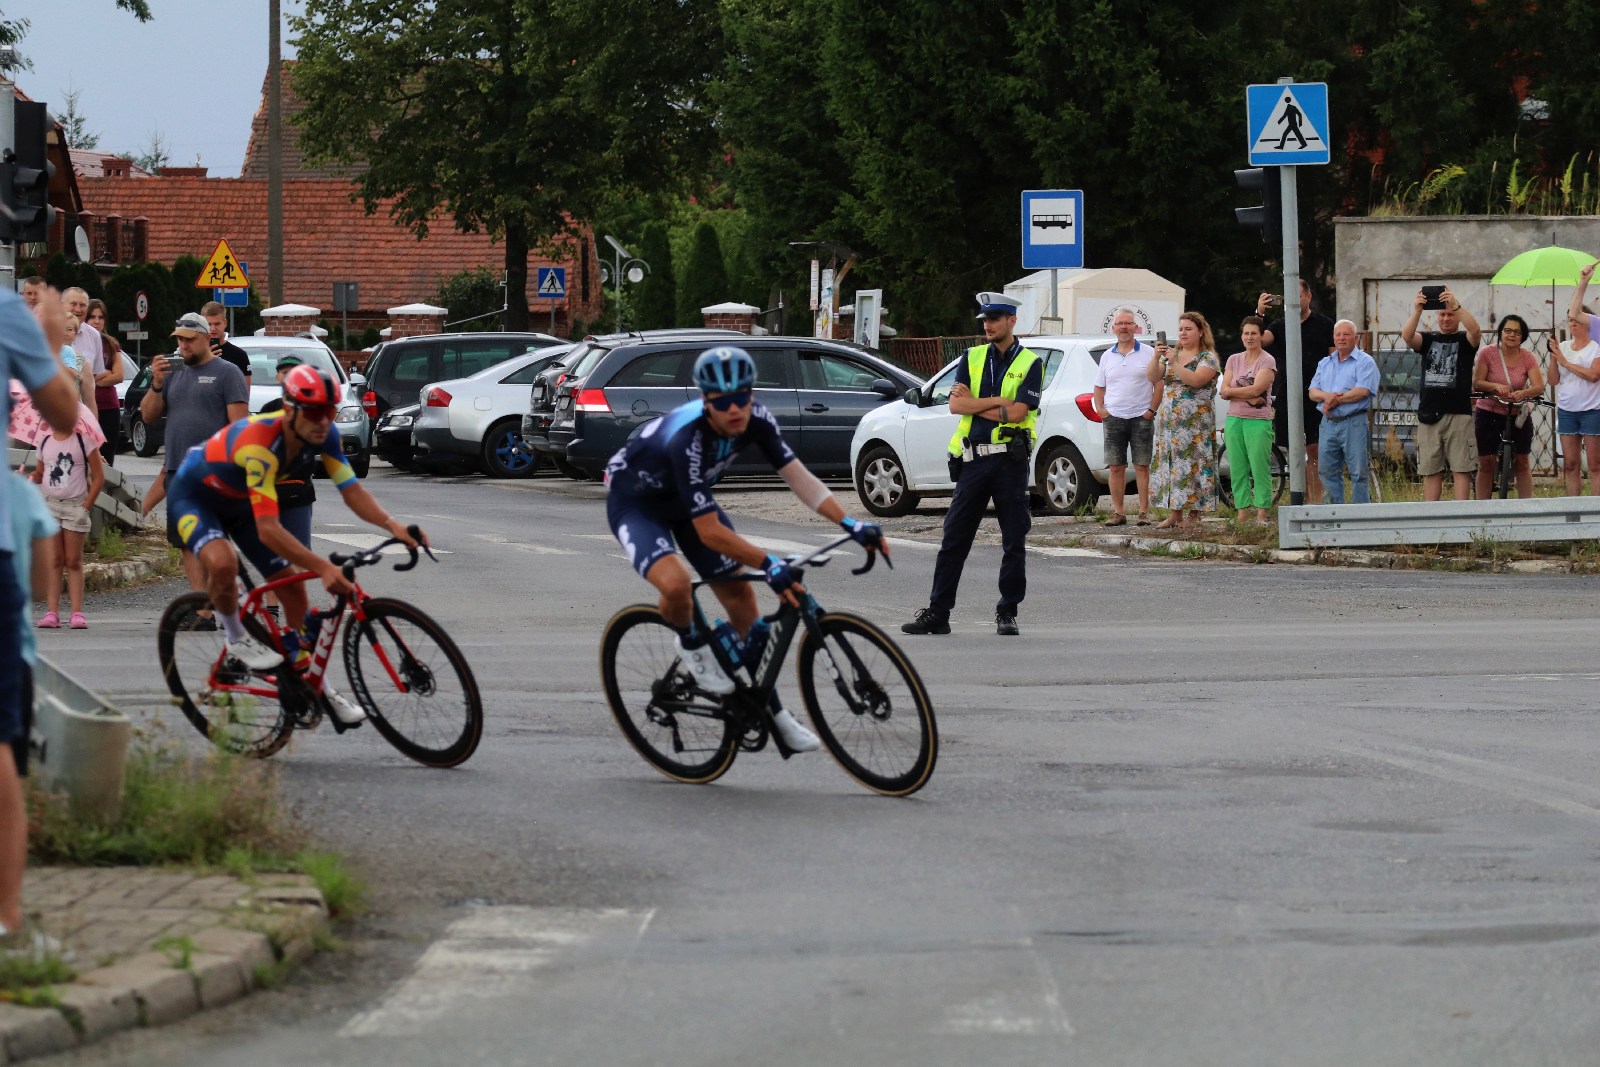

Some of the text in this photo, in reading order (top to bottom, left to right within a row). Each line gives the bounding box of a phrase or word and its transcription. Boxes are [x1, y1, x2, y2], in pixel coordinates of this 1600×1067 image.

[1136, 309, 1152, 335] POLSK
[1027, 389, 1040, 398] POLIC
[307, 614, 340, 677] TRE
